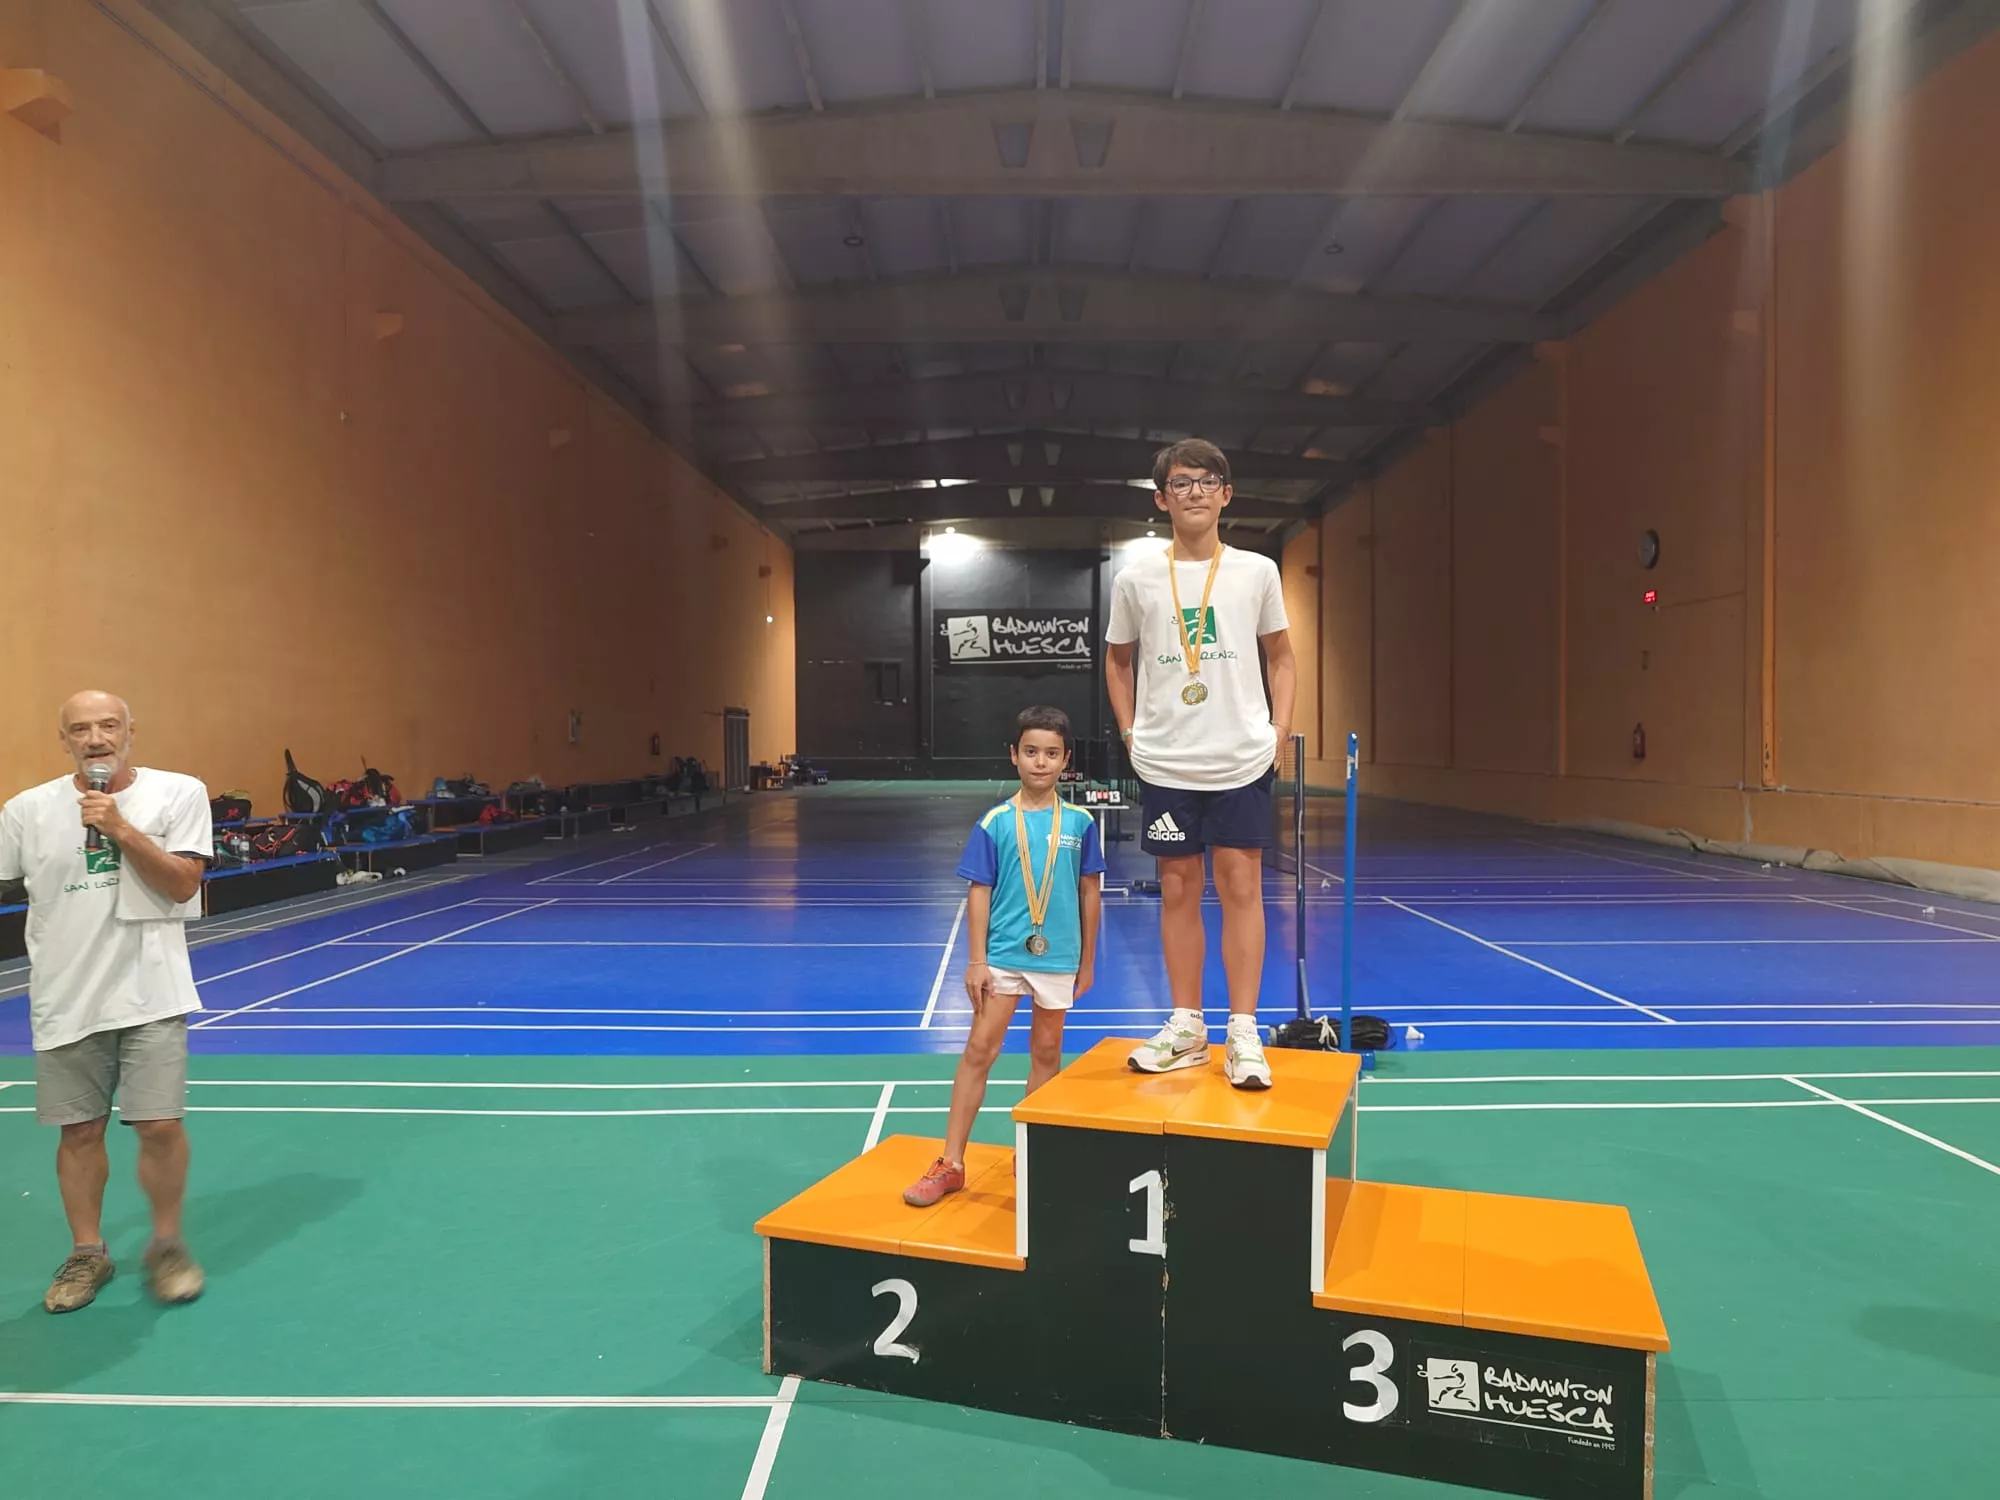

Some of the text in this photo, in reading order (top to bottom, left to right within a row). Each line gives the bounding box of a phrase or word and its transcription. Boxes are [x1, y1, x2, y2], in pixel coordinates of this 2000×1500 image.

[992, 635, 1091, 657] HUESCA
[1157, 653, 1182, 665] SAN
[1085, 790, 1098, 803] 14
[1109, 790, 1121, 803] 13
[1147, 829, 1186, 841] adidas
[63, 881, 89, 893] SAN
[1129, 1169, 1167, 1259] 1
[871, 1278, 920, 1365] 2
[1342, 1329, 1399, 1423] 3
[1484, 1391, 1614, 1435] HUESCA
